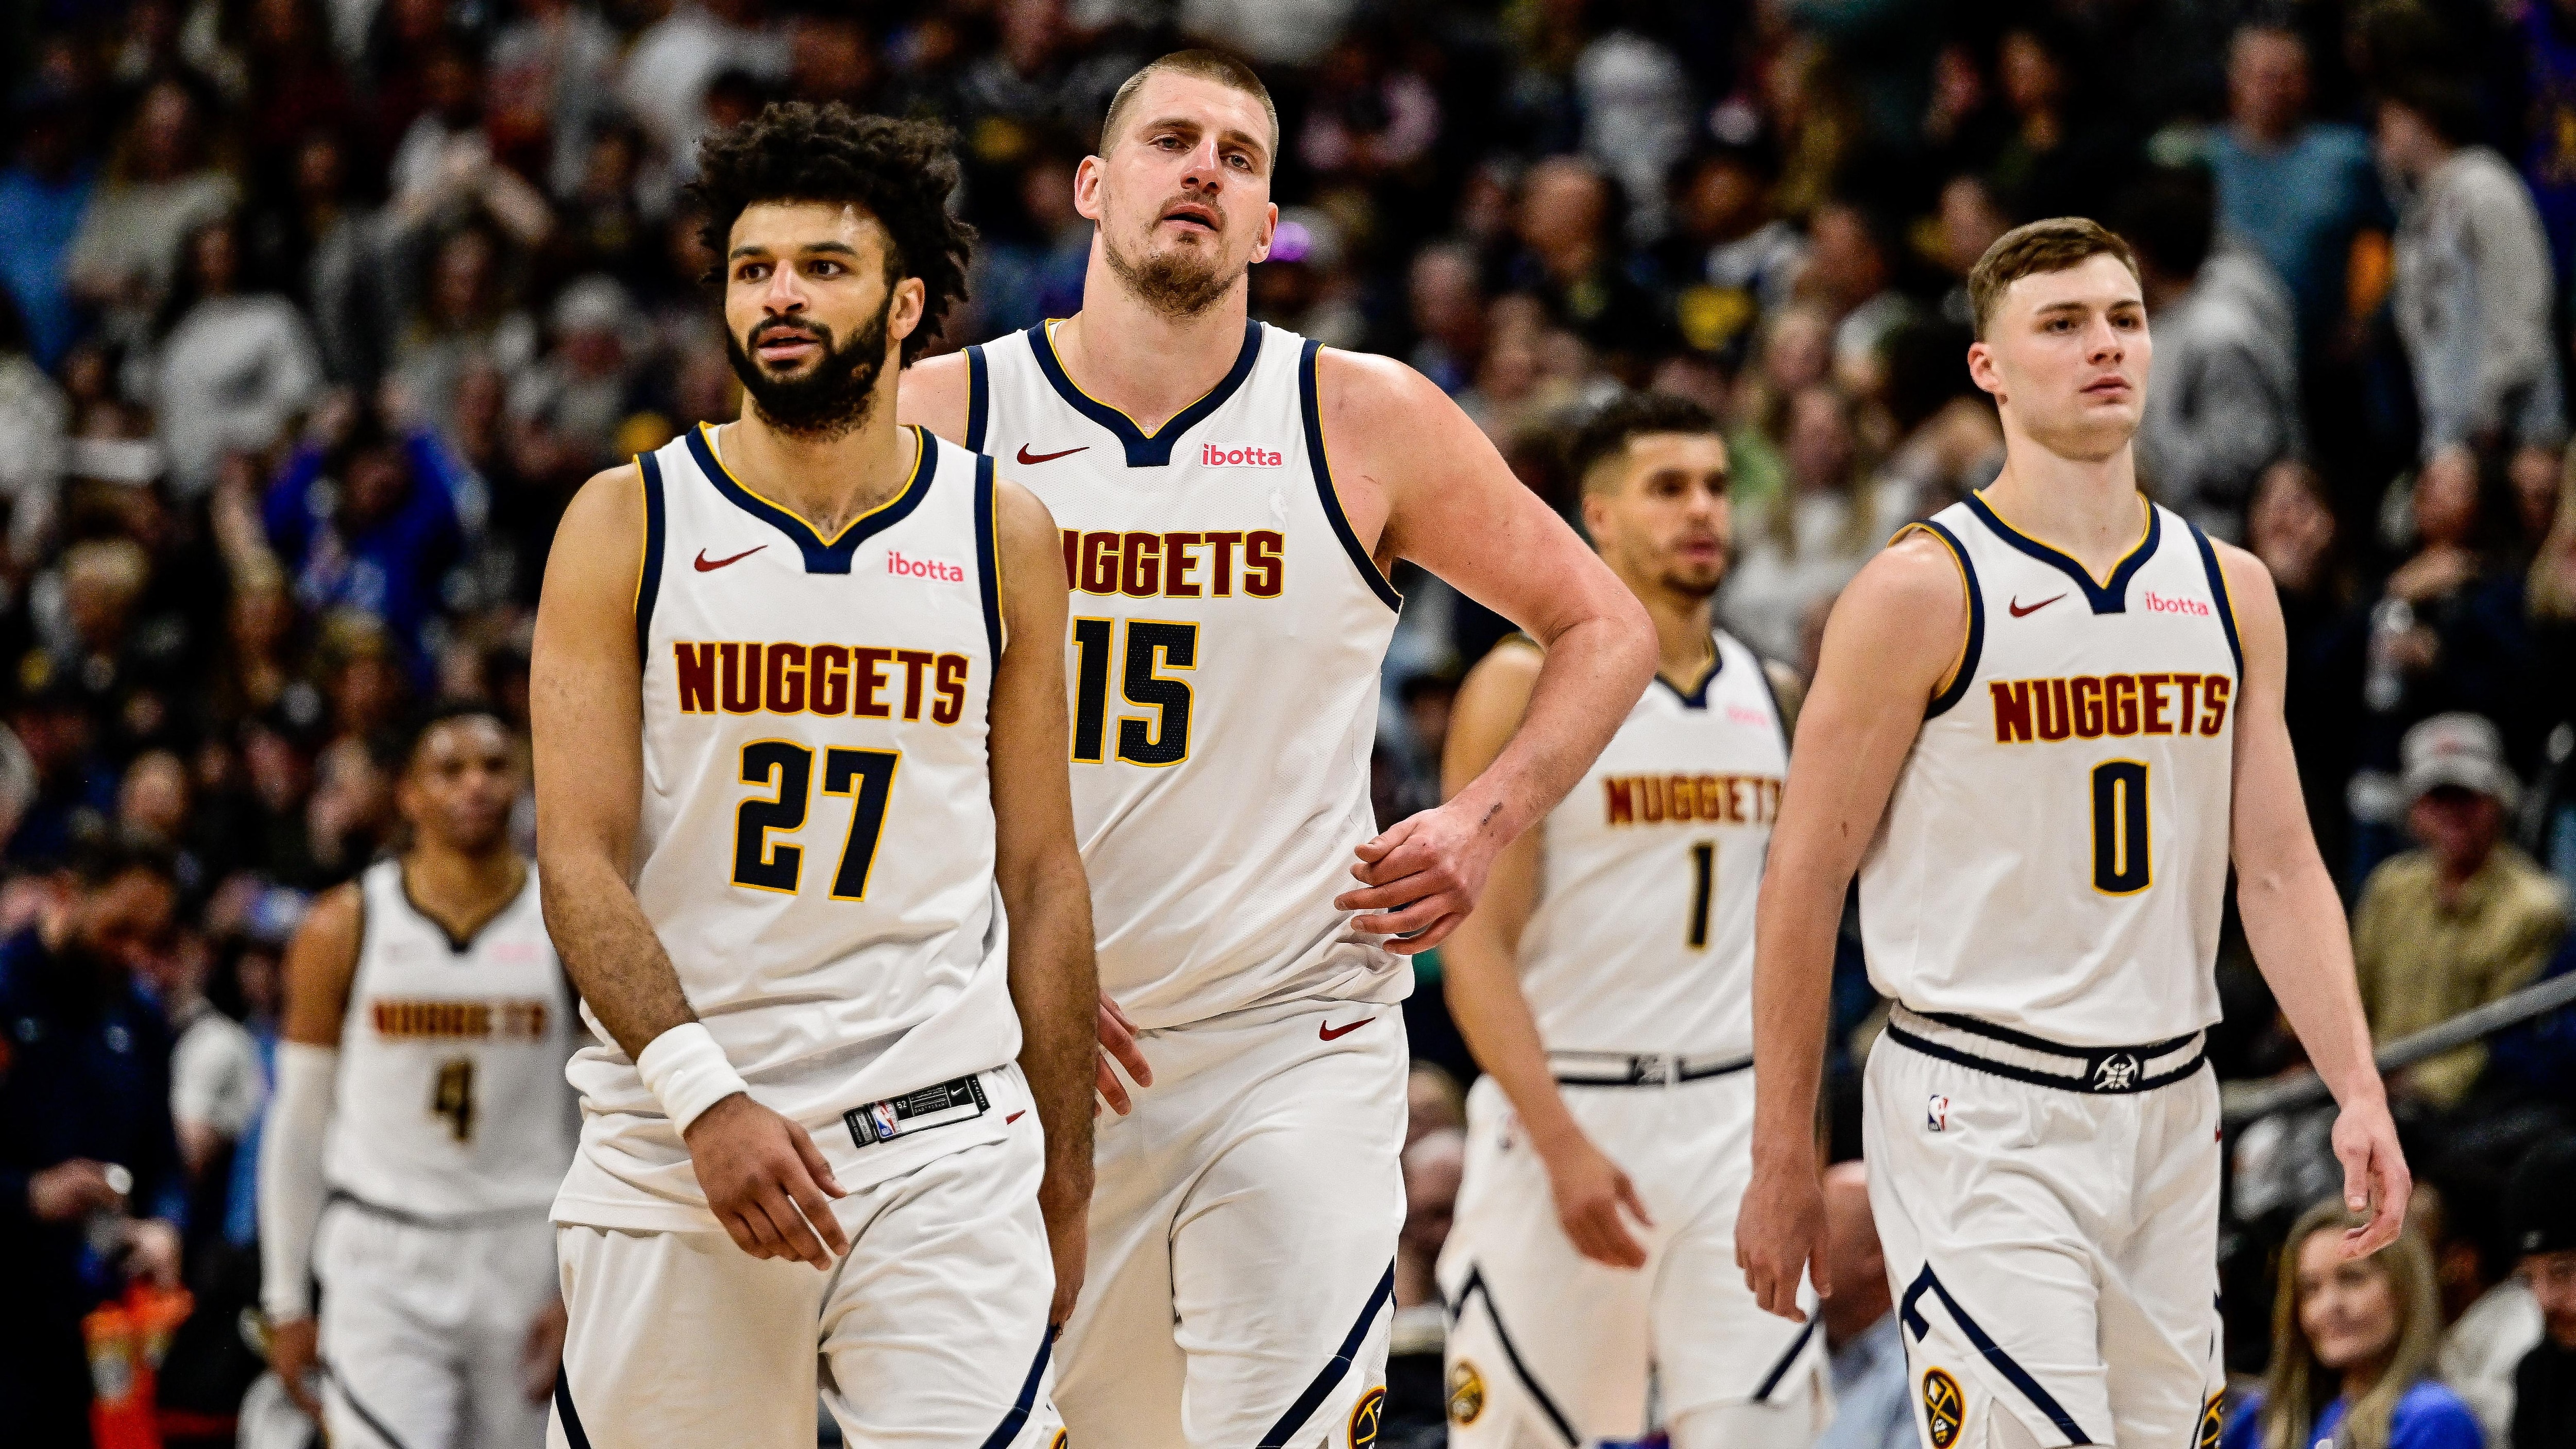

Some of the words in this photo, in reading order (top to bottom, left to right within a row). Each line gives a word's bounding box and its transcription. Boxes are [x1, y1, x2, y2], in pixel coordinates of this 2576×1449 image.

[1202, 444, 1282, 466] ibotta
[888, 551, 964, 582] ibotta
[1058, 528, 1285, 599] GGETS
[2145, 592, 2210, 616] ibotta
[673, 641, 969, 727] NUGGETS
[1071, 616, 1200, 767] 15
[1989, 673, 2231, 745] NUGGETS
[731, 737, 902, 902] 27
[2089, 757, 2153, 897] 0
[1687, 839, 1717, 951] 1
[432, 1055, 475, 1143] 4
[896, 1100, 907, 1109] 52
